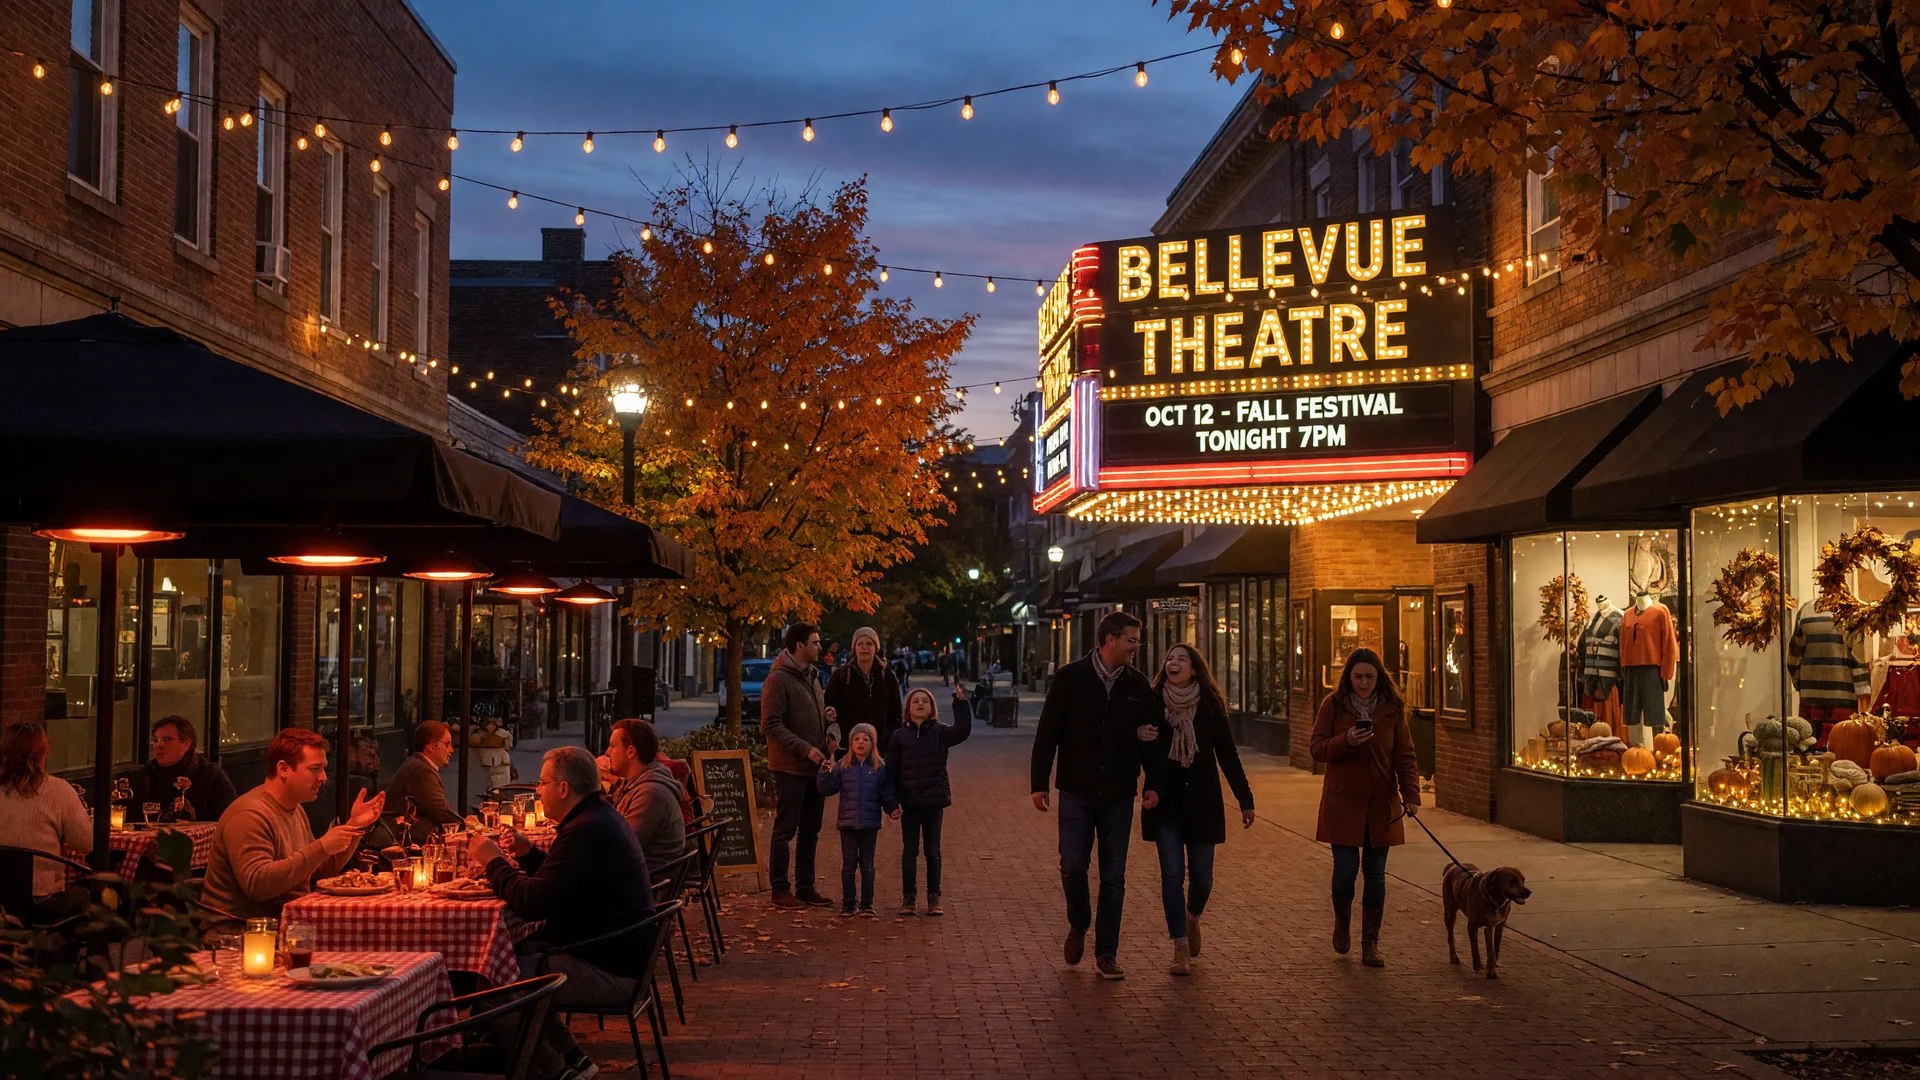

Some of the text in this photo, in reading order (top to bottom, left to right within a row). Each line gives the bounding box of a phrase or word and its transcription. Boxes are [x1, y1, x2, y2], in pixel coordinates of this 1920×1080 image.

[1118, 214, 1427, 302] BELLEVUE
[1134, 299, 1408, 375] THEATRE
[1145, 405, 1188, 428] OCT
[1193, 403, 1214, 426] 12
[1236, 398, 1290, 423] FALL
[1296, 392, 1404, 420] FESTIVAL
[1195, 423, 1346, 453] TONIGHT 7PM
